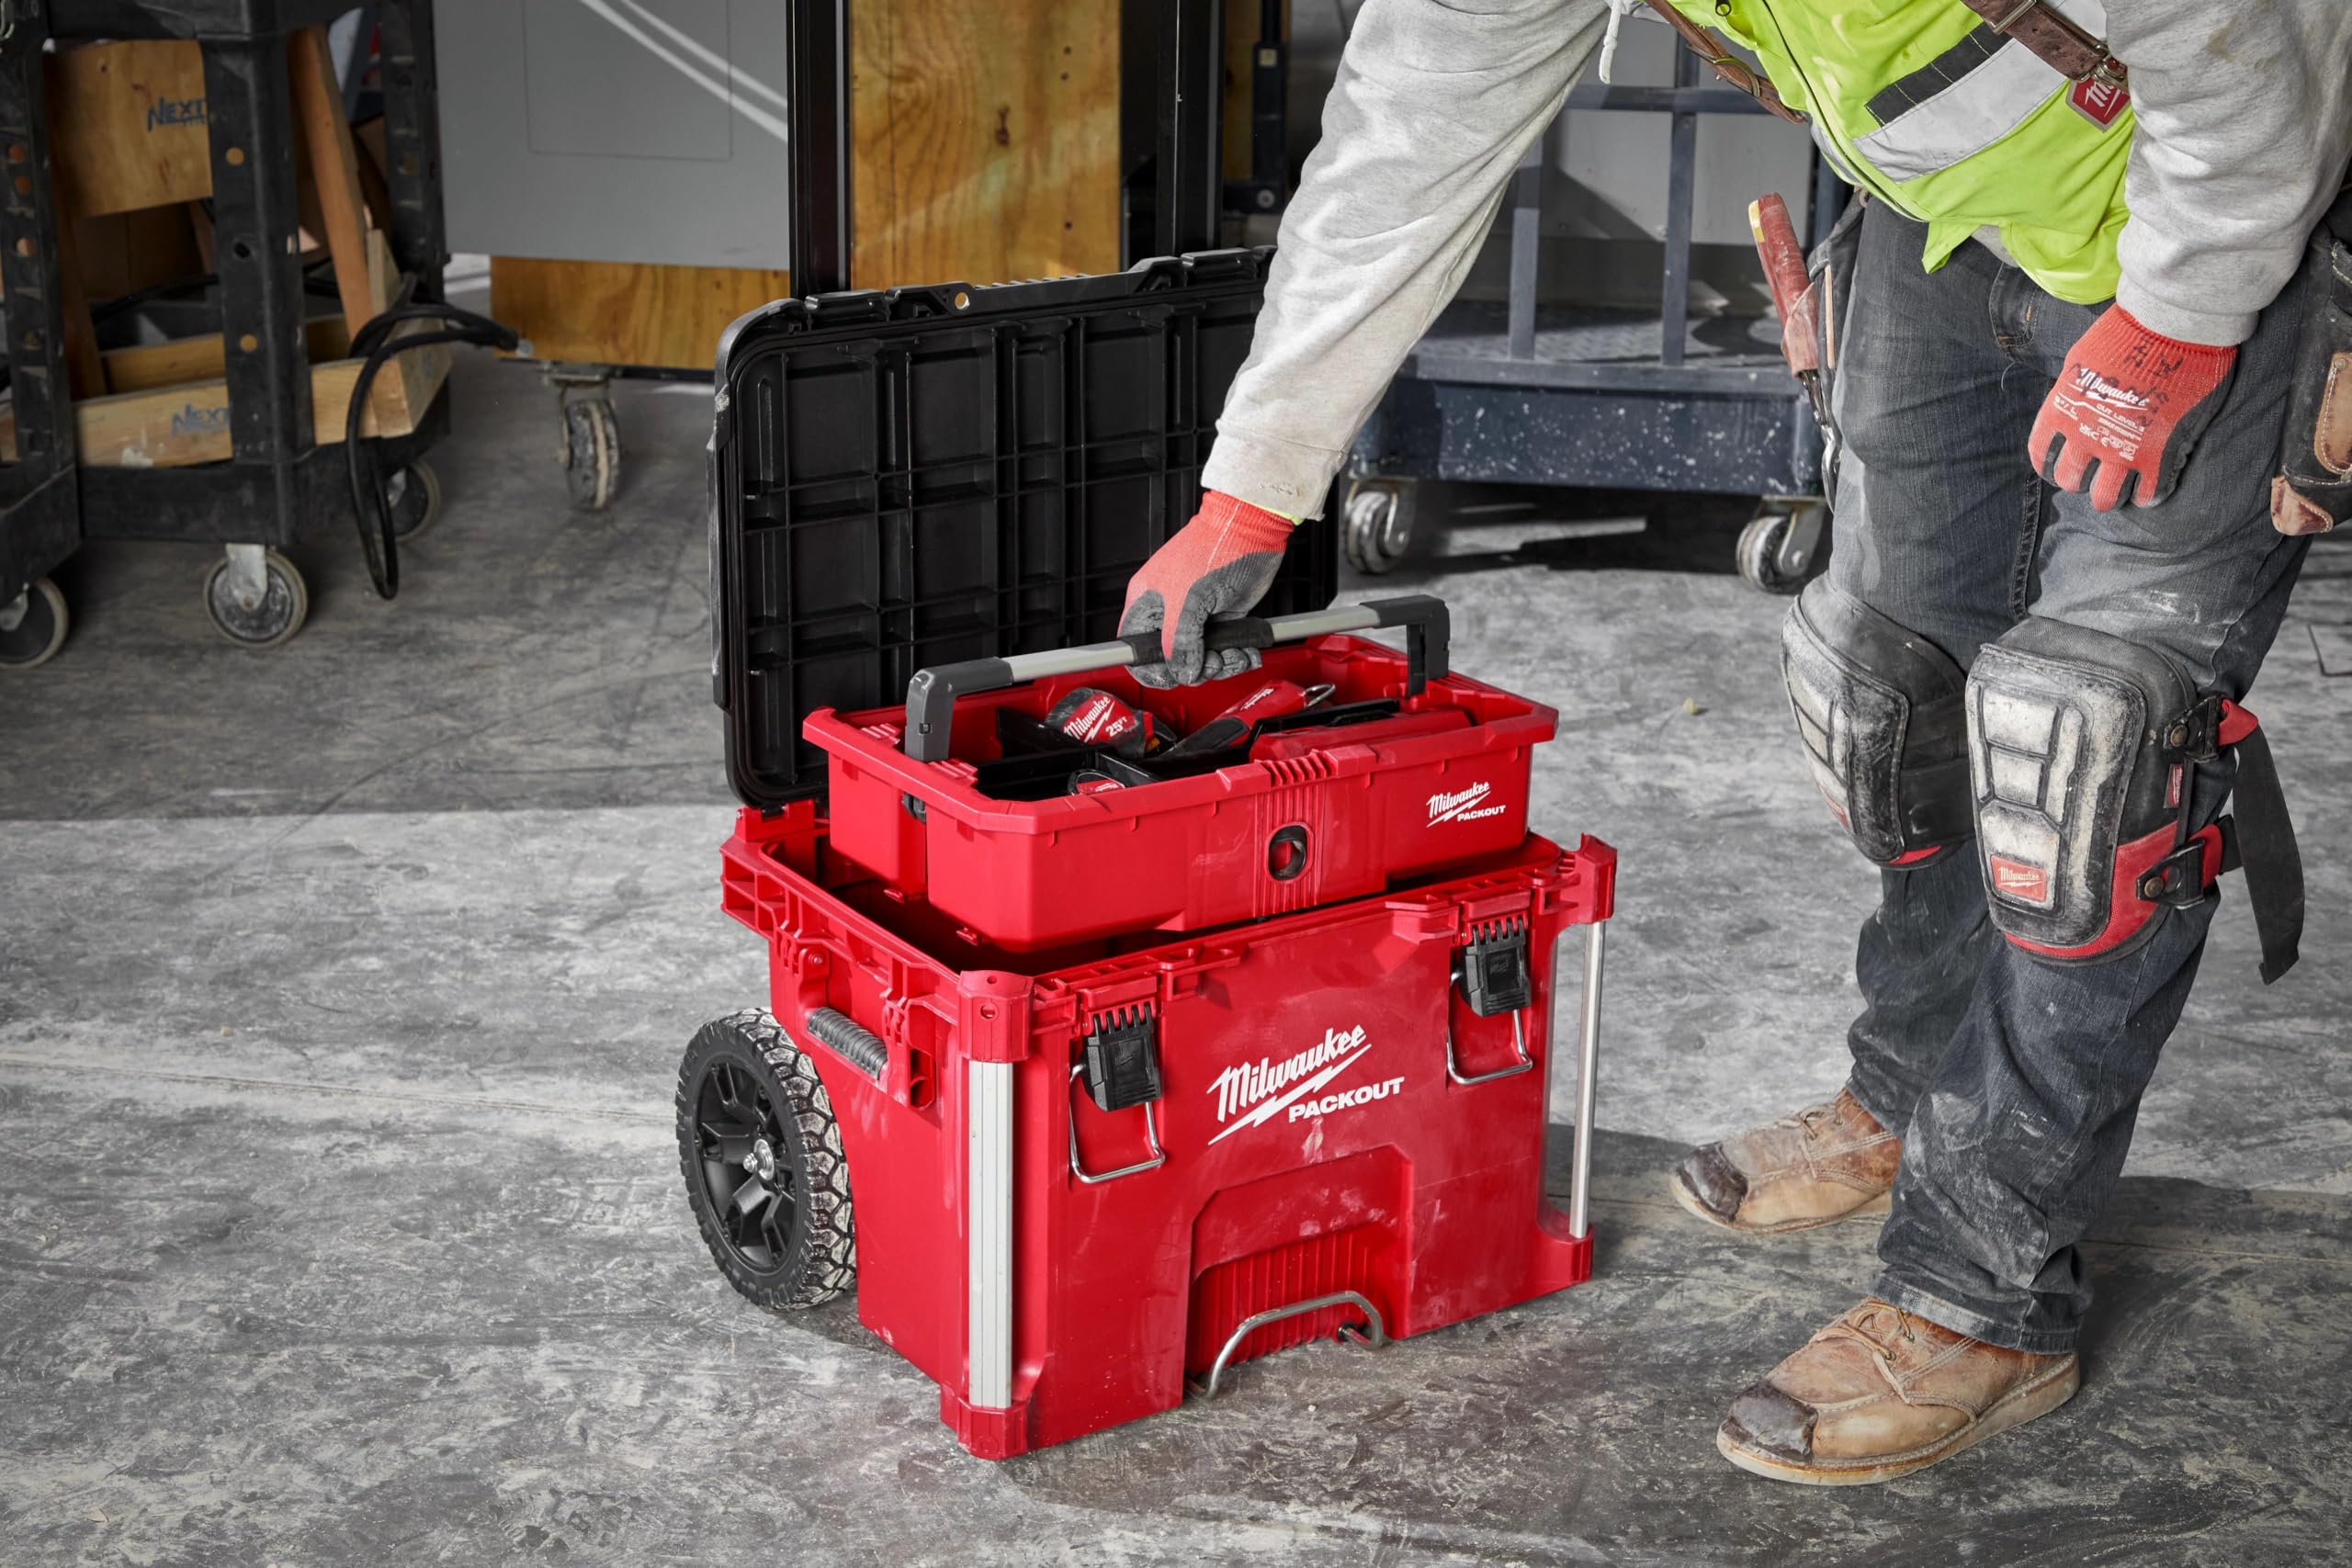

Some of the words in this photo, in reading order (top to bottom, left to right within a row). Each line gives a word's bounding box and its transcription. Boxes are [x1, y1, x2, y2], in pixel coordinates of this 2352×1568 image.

[2075, 367, 2147, 407] Milwaukee
[2096, 403, 2113, 414] CUT
[1063, 696, 1111, 740] Milwaukee
[1426, 781, 1490, 818] Milwaukee
[1457, 805, 1506, 822] PACKOUT
[1997, 866, 2040, 882] Milwaukee
[1206, 1024, 1367, 1122] Milwaukee
[1288, 1076, 1405, 1123] PACKOUT
